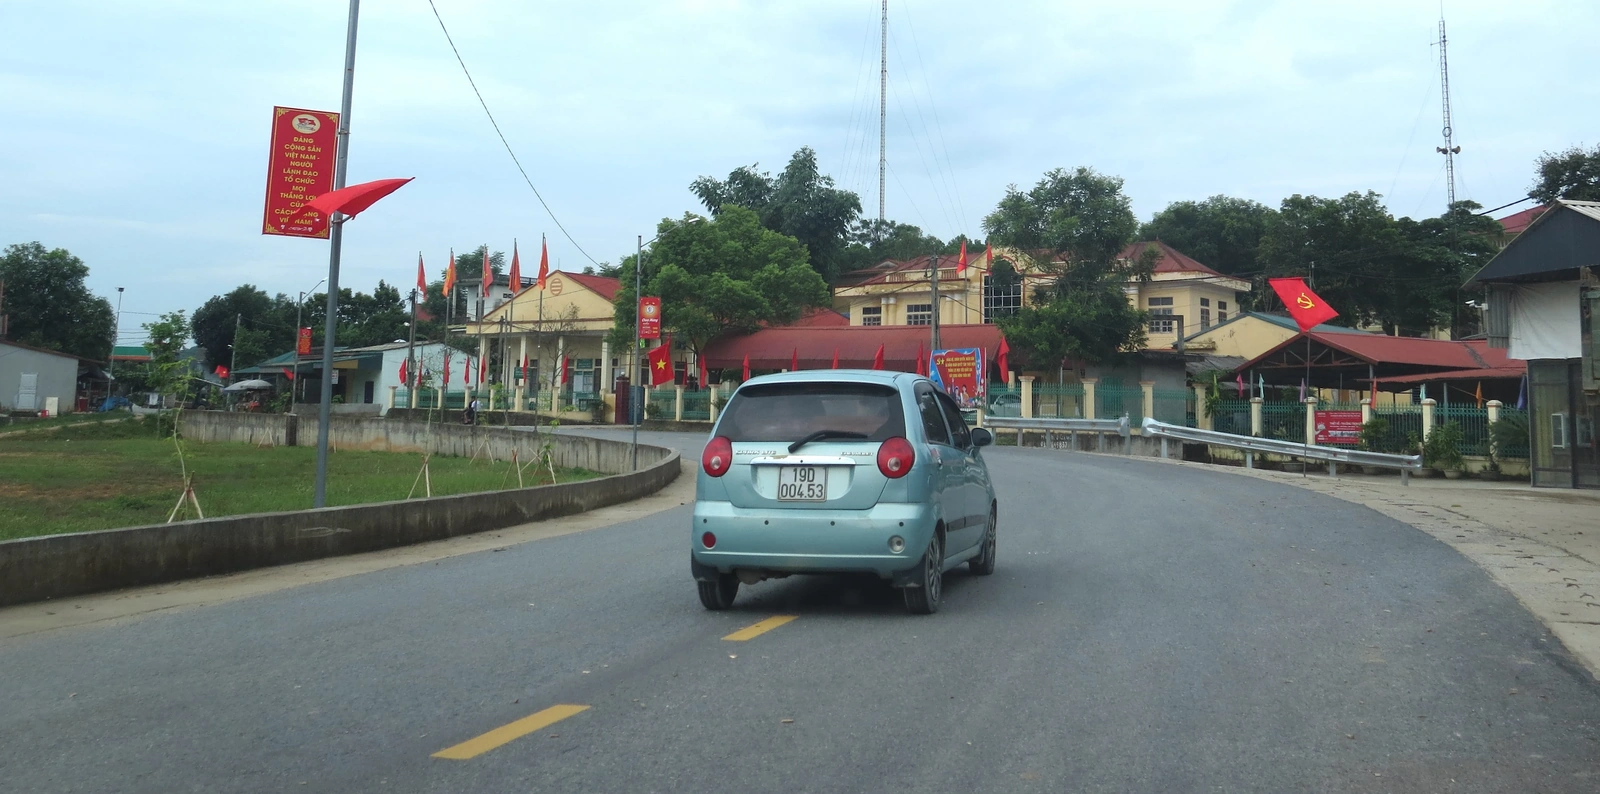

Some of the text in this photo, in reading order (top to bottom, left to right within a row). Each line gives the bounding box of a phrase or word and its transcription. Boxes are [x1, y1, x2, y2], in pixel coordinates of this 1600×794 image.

[284, 143, 306, 151] CỘNG
[284, 151, 299, 159] VIỆT
[793, 467, 815, 483] 19D
[780, 483, 824, 498] 004.53
